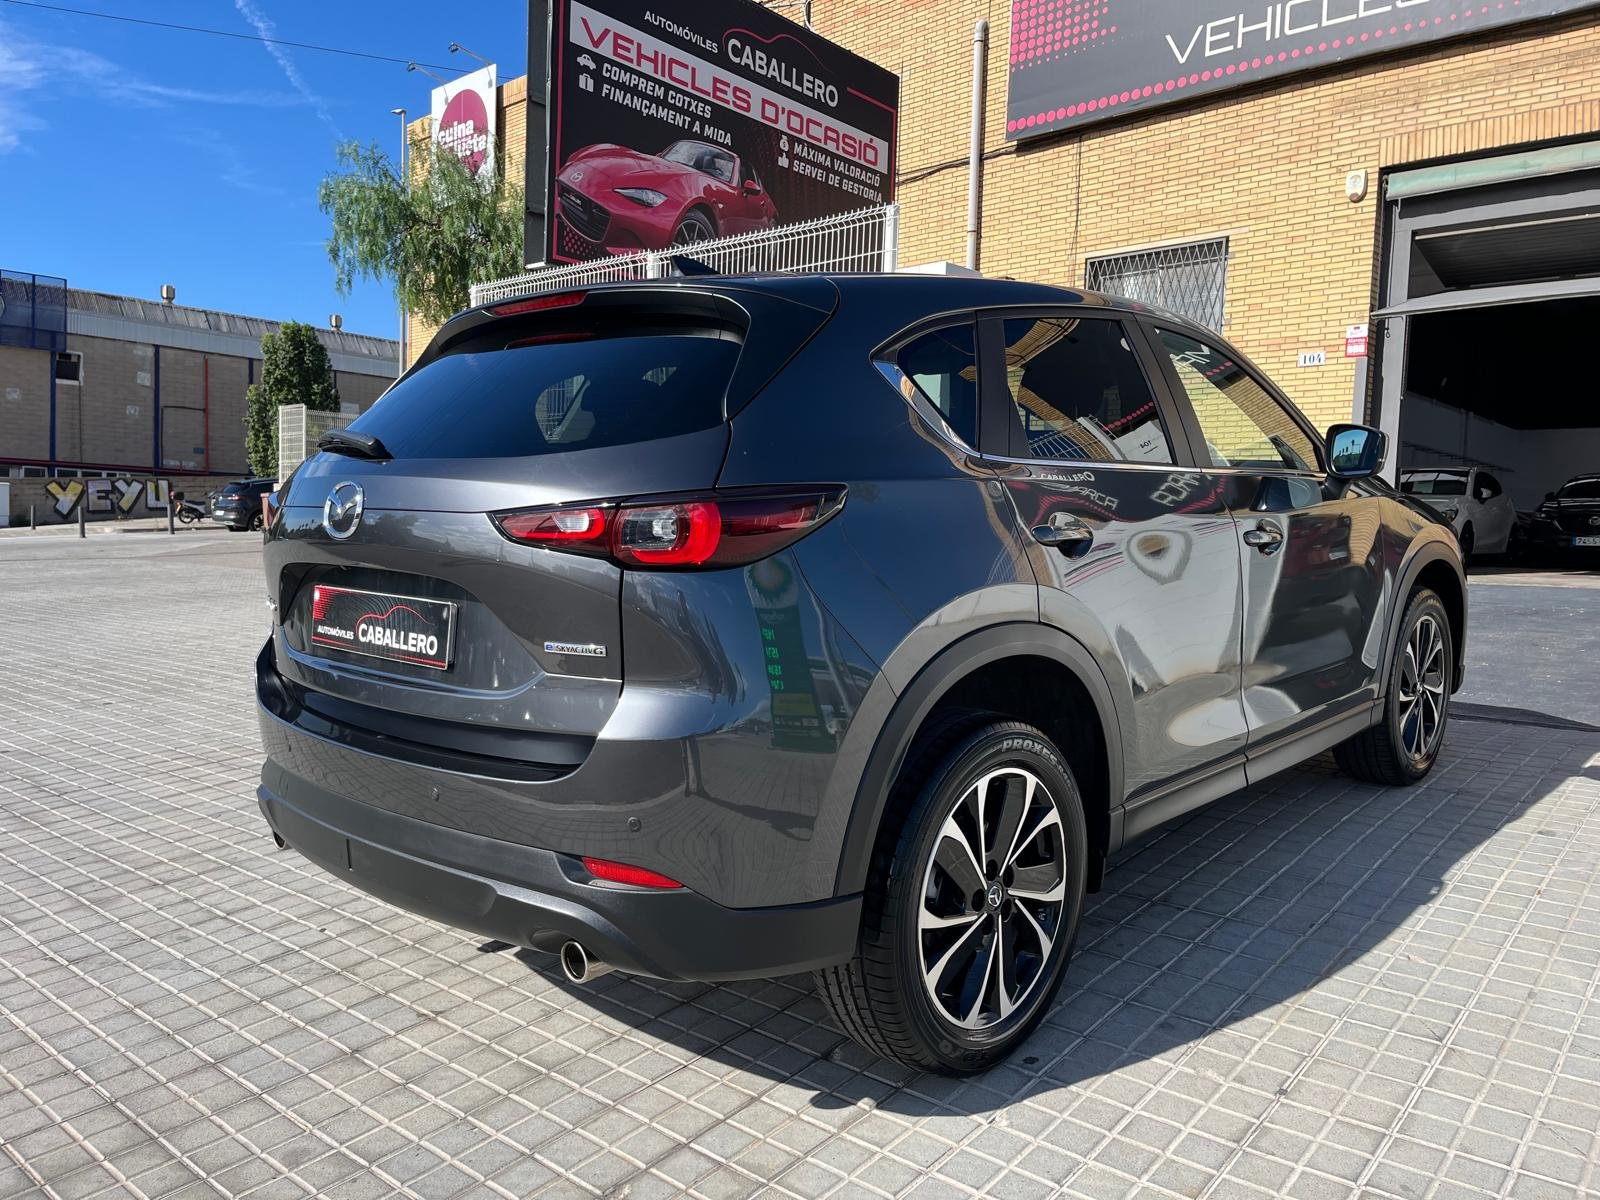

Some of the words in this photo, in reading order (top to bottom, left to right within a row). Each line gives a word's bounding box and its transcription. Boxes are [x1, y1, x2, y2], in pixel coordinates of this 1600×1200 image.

[1165, 0, 1430, 64] VEHICLE
[644, 10, 719, 54] AUTOMÓVILES
[727, 38, 839, 108] CABALLERO
[580, 16, 752, 113] VEHICLES
[760, 97, 878, 167] D'OCASIÓ
[602, 62, 665, 100] COMPREM
[667, 90, 712, 119] COTXES
[438, 119, 474, 145] cuina
[601, 83, 692, 130] FINANÇAMENT
[692, 120, 701, 134] A
[703, 124, 732, 146] MIDA
[793, 142, 831, 168] MÀXIMA
[834, 159, 881, 187] VALORACIÓ
[793, 160, 826, 183] SERVEI
[828, 174, 841, 188] DE
[842, 179, 883, 204] GESTORIA
[1303, 353, 1322, 365] 104
[317, 624, 355, 640] AUTOMÓVILES
[358, 623, 438, 656] CABALLERO
[1001, 738, 1058, 765] PROXES
